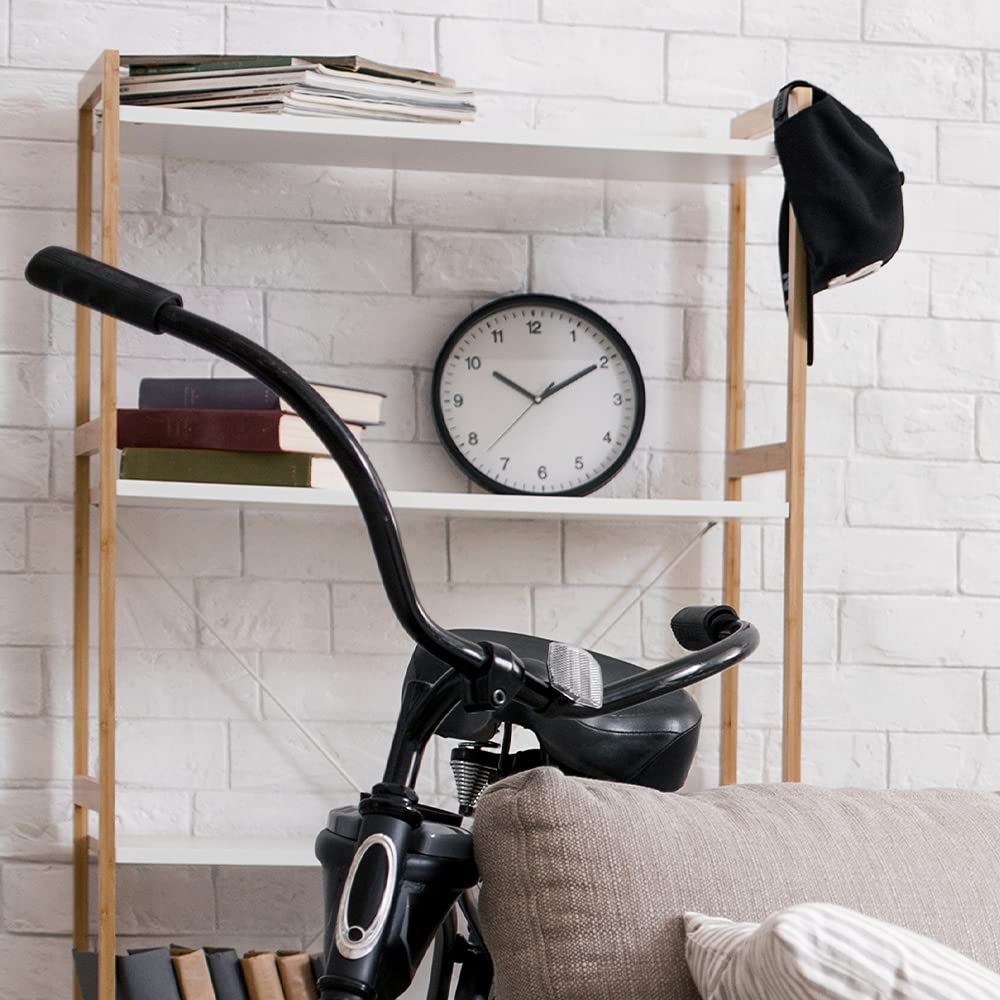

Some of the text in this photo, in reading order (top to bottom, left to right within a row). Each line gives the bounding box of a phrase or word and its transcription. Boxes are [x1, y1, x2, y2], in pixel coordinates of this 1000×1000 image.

[526, 320, 542, 334] 12
[491, 329, 504, 343] 11
[570, 330, 576, 342] 1
[465, 356, 481, 370] 10
[599, 355, 609, 369] 2
[453, 394, 464, 408] 9
[612, 393, 623, 406] 3
[467, 432, 478, 446] 8
[602, 431, 612, 444] 4
[500, 457, 510, 471] 7
[574, 456, 584, 470] 5
[537, 466, 548, 480] 6
